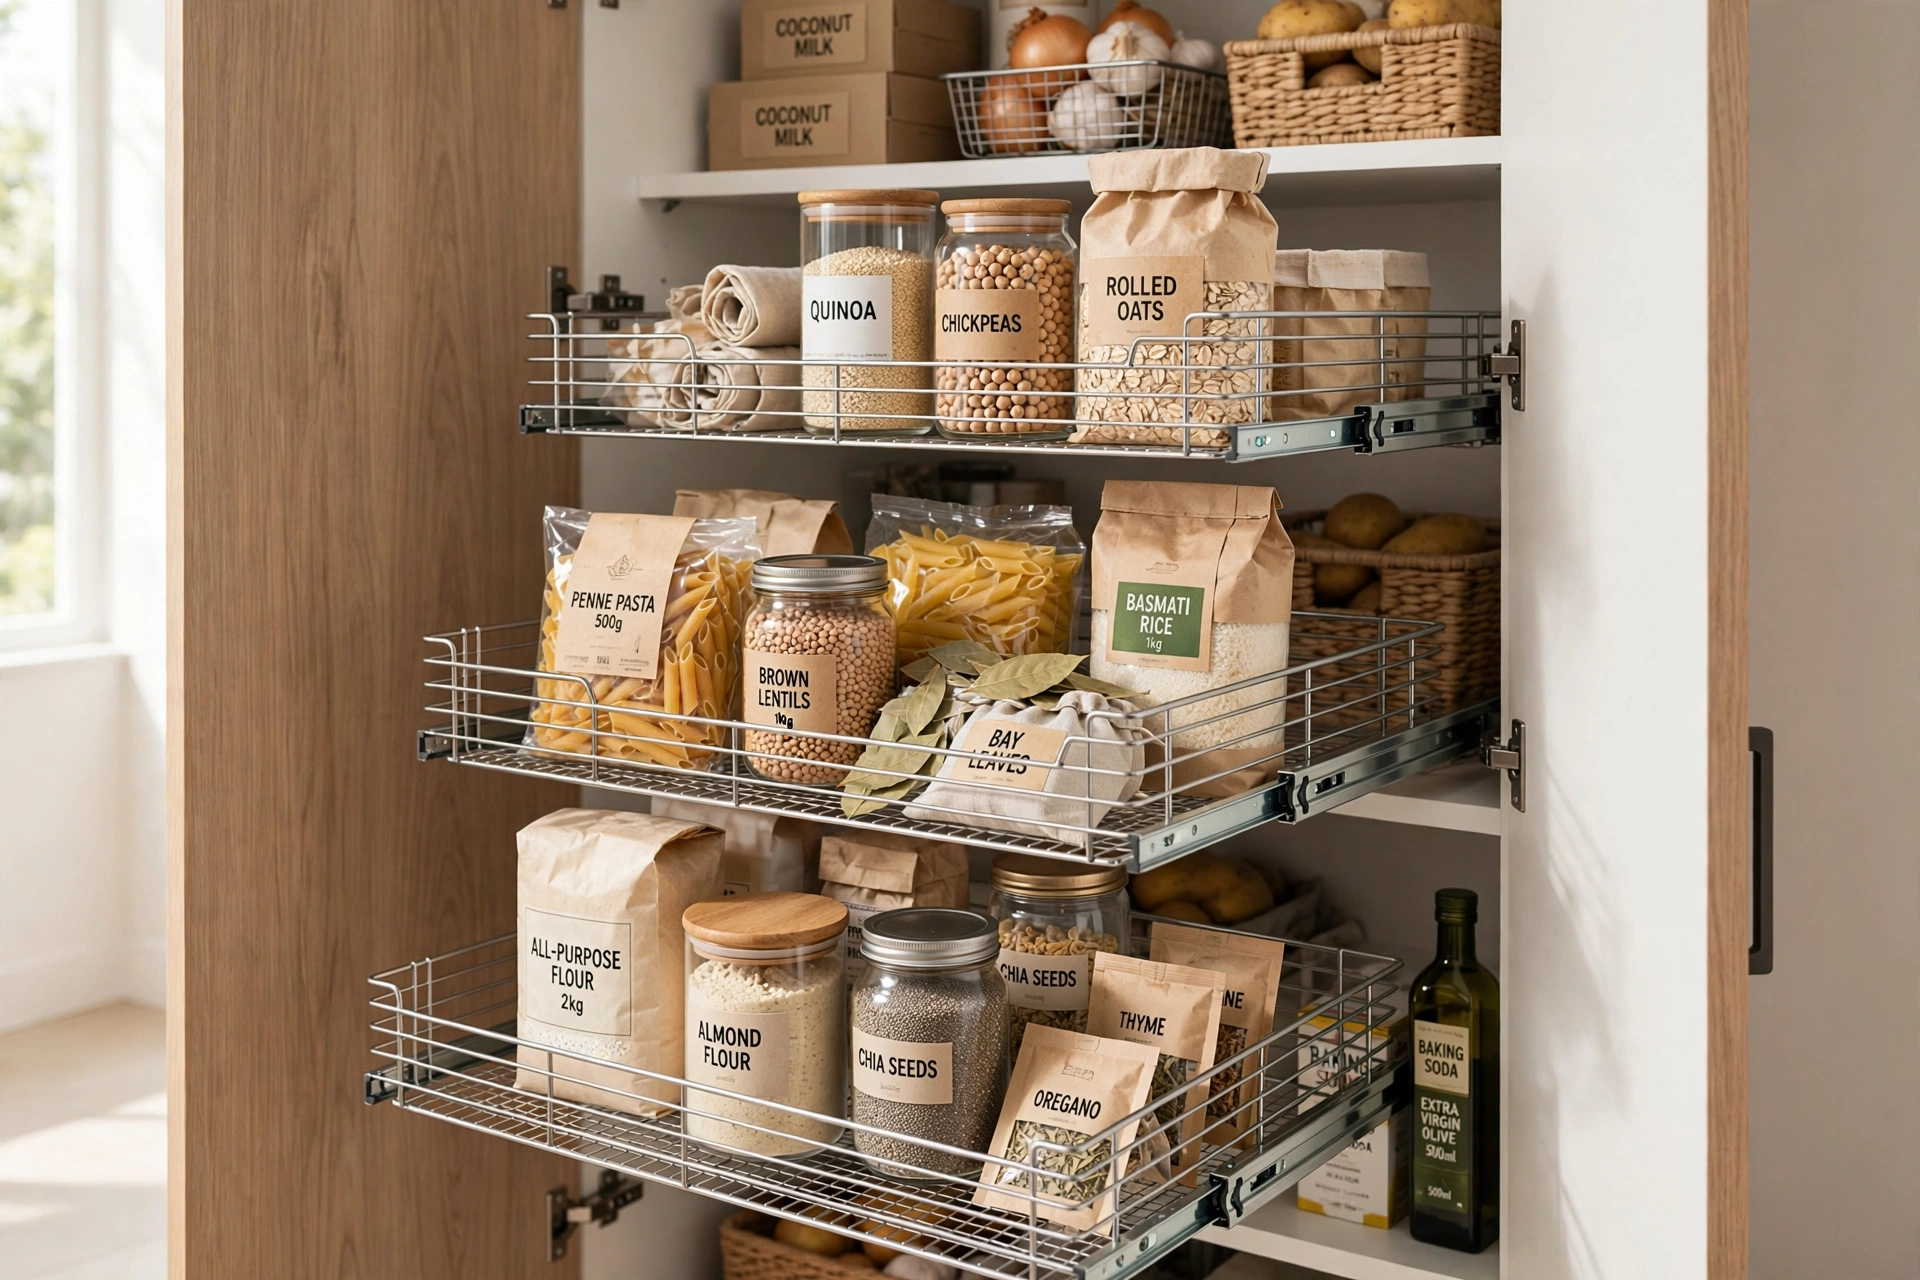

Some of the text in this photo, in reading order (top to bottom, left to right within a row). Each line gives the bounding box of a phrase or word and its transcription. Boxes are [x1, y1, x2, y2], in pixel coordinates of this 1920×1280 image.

[775, 13, 853, 37] COCONUT
[794, 37, 834, 58] MILK
[755, 104, 832, 126] COCONUT
[774, 127, 814, 147] MILK
[1106, 275, 1177, 296] ROLLED
[810, 299, 877, 322] QUINOA
[1117, 300, 1164, 321] OATS
[941, 313, 1023, 333] CHICKPEAS
[570, 591, 656, 613] PENNE PASTA
[1126, 593, 1191, 616] BASMATI
[594, 613, 623, 633] 500g
[1139, 615, 1174, 635] RICE
[1146, 636, 1163, 653] 1kg
[759, 666, 809, 688] BROWN
[758, 688, 811, 710] LENTILS
[988, 729, 1026, 750] BAY
[967, 749, 1031, 775] LEAVES
[530, 936, 622, 970] ALL-PURPOSE
[551, 964, 595, 991] FLOUR
[1000, 963, 1078, 988] CHIA SEEDS
[561, 993, 584, 1017] 2kg
[698, 1020, 762, 1048] ALMOND
[1119, 1010, 1167, 1036] THYME
[703, 1045, 752, 1071] FLOUR
[1418, 1039, 1465, 1061] BAKING
[858, 1047, 938, 1079] CHIA SEEDS
[1424, 1058, 1459, 1079] SODA
[1033, 1089, 1102, 1120] OREGANO
[1420, 1096, 1460, 1117] EXTRA
[1420, 1110, 1462, 1133] VIRGIN
[1421, 1126, 1457, 1146] OLIVE
